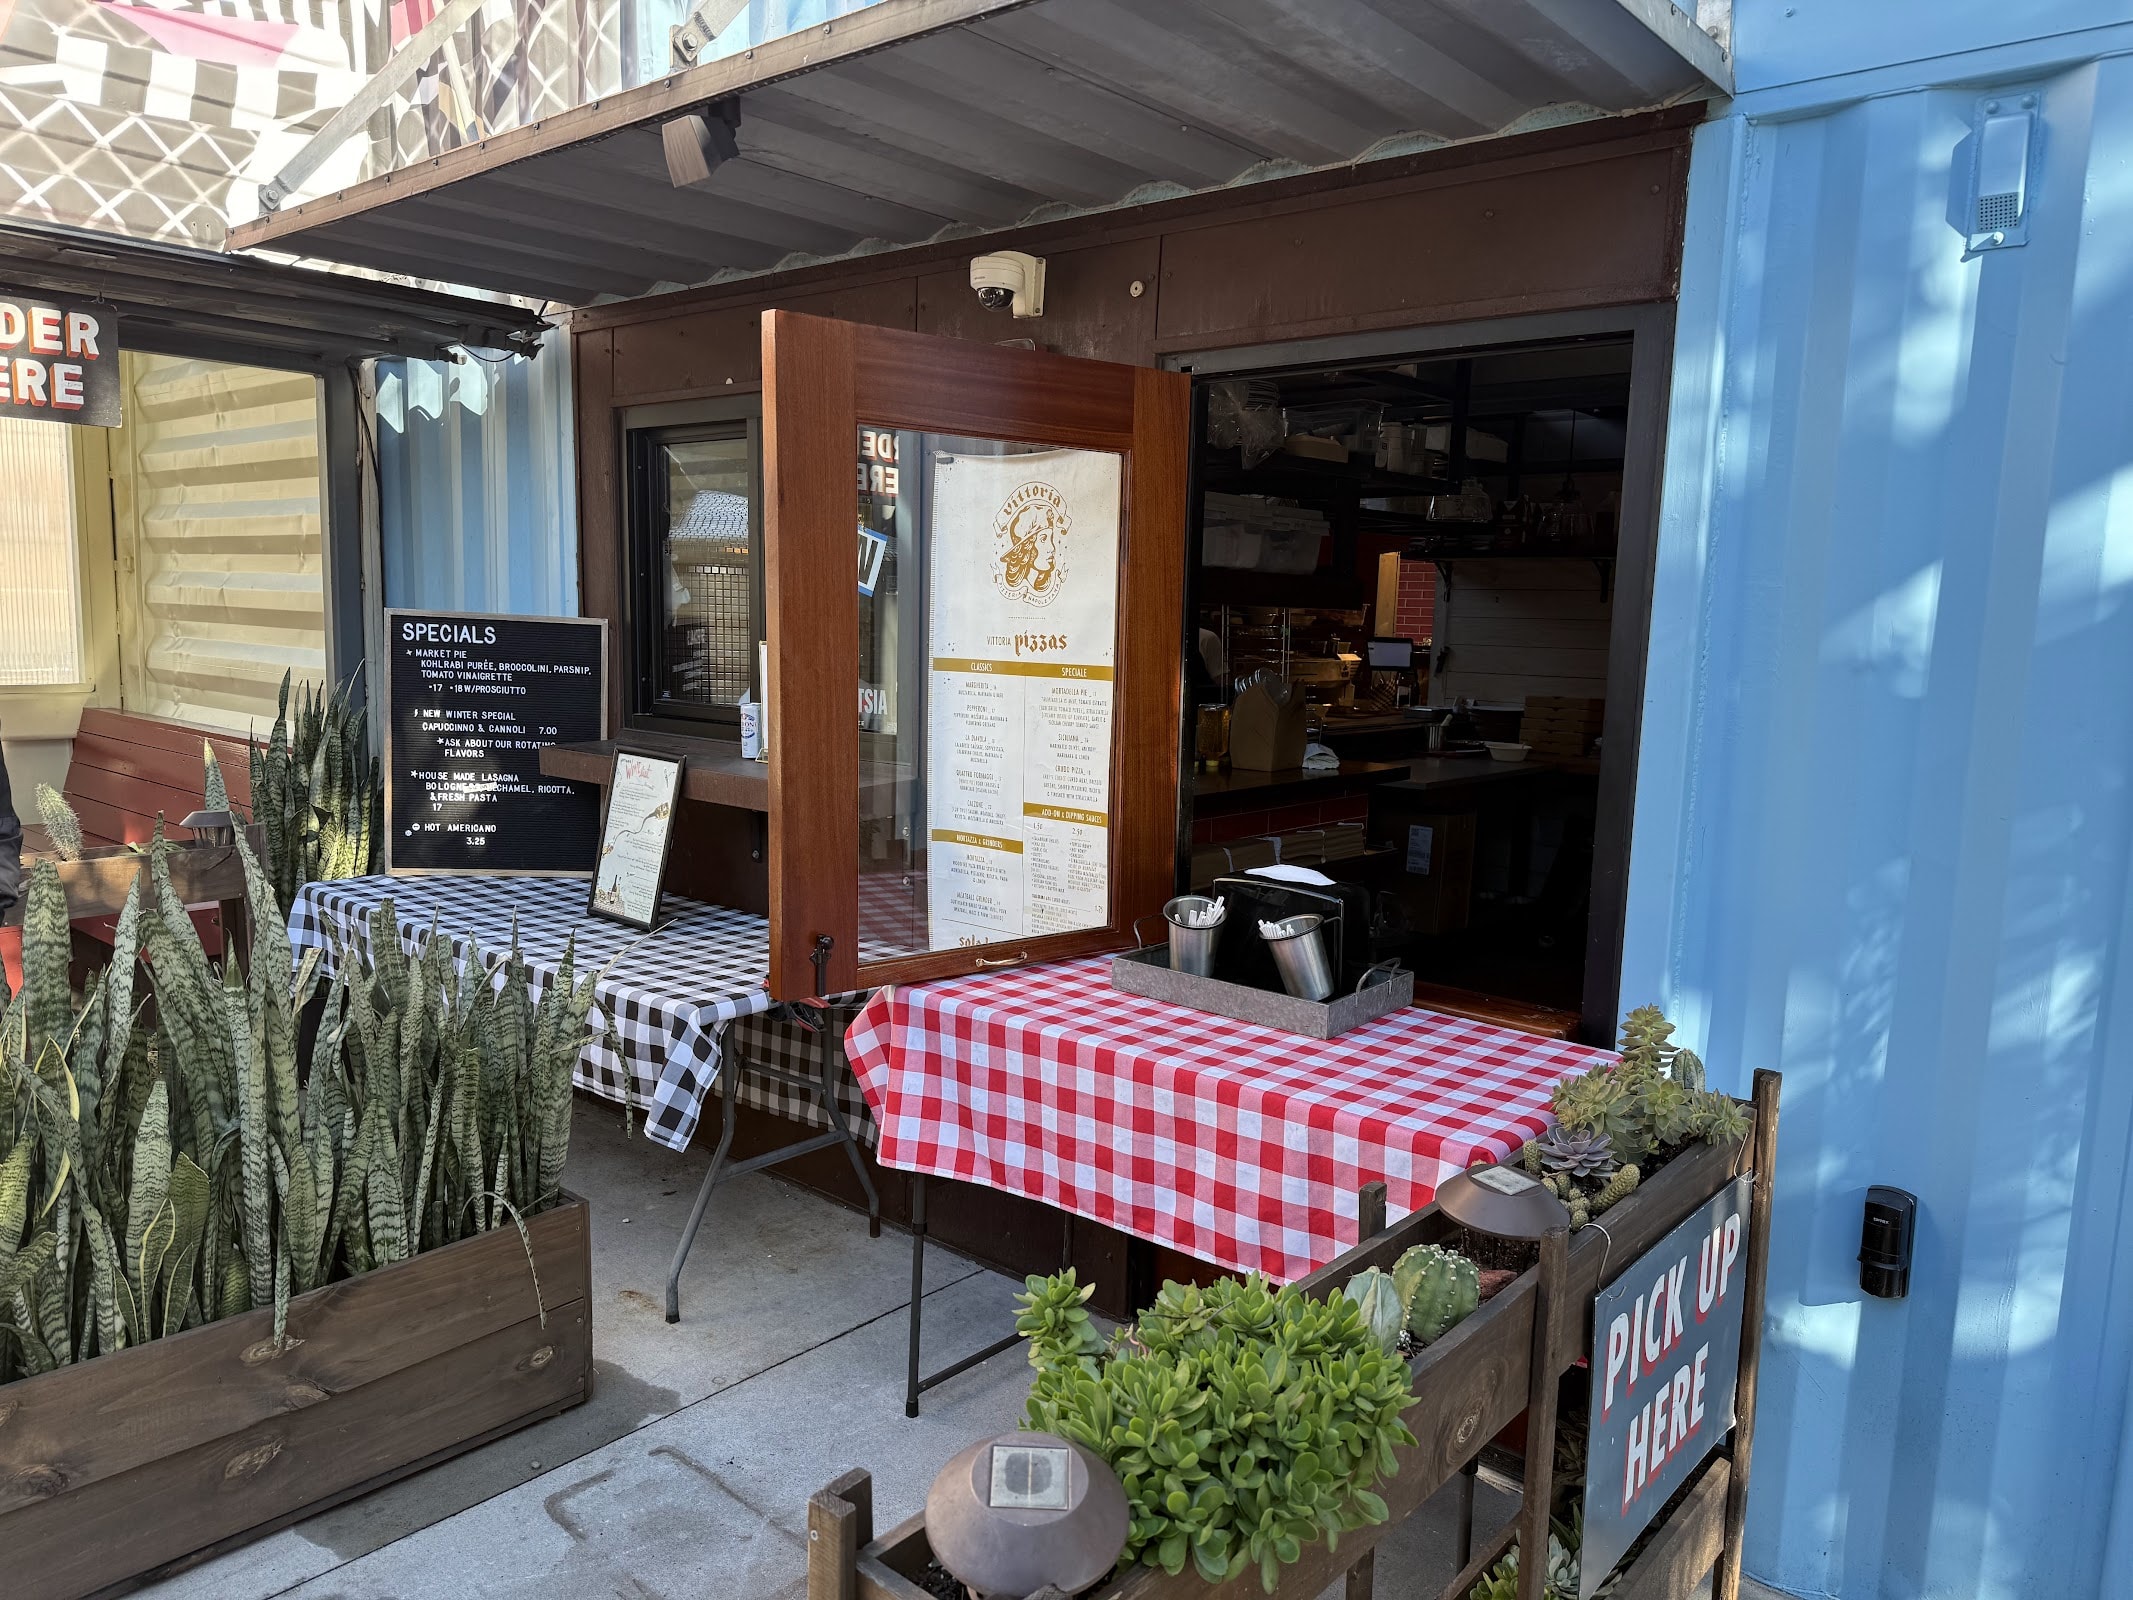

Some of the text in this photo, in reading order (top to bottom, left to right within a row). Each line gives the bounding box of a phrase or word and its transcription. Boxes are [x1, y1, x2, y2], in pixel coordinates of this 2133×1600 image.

[402, 622, 497, 645] SPECIALS
[986, 629, 1068, 657] VITTORIA pizzas
[415, 649, 467, 659] MARKET PIE
[421, 659, 464, 670] KOHLRABI
[970, 662, 993, 673] CLASSICS
[421, 669, 513, 682] TOMATO VINAIGRETTE
[1061, 667, 1087, 678] SPECIALE
[423, 708, 517, 721] NEW WINTER SPECIAL
[477, 723, 485, 733] &
[488, 724, 526, 735] CANNOLI
[538, 726, 558, 735] 7.00
[444, 738, 461, 748] ASK
[464, 738, 494, 749] ABOUT
[495, 739, 512, 749] OUR
[444, 749, 485, 758] FLAVORS
[418, 771, 520, 783] HOUSE MADE LASAGNA
[468, 793, 498, 803] PASTA
[432, 802, 443, 812] 17
[1066, 811, 1084, 821] DIPPING
[1086, 814, 1102, 824] SAUCES
[424, 823, 497, 833] HOT AMERICANO
[466, 837, 486, 846] 3.25
[1602, 1212, 1741, 1420] PICK UP
[1623, 1341, 1709, 1513] HERE
